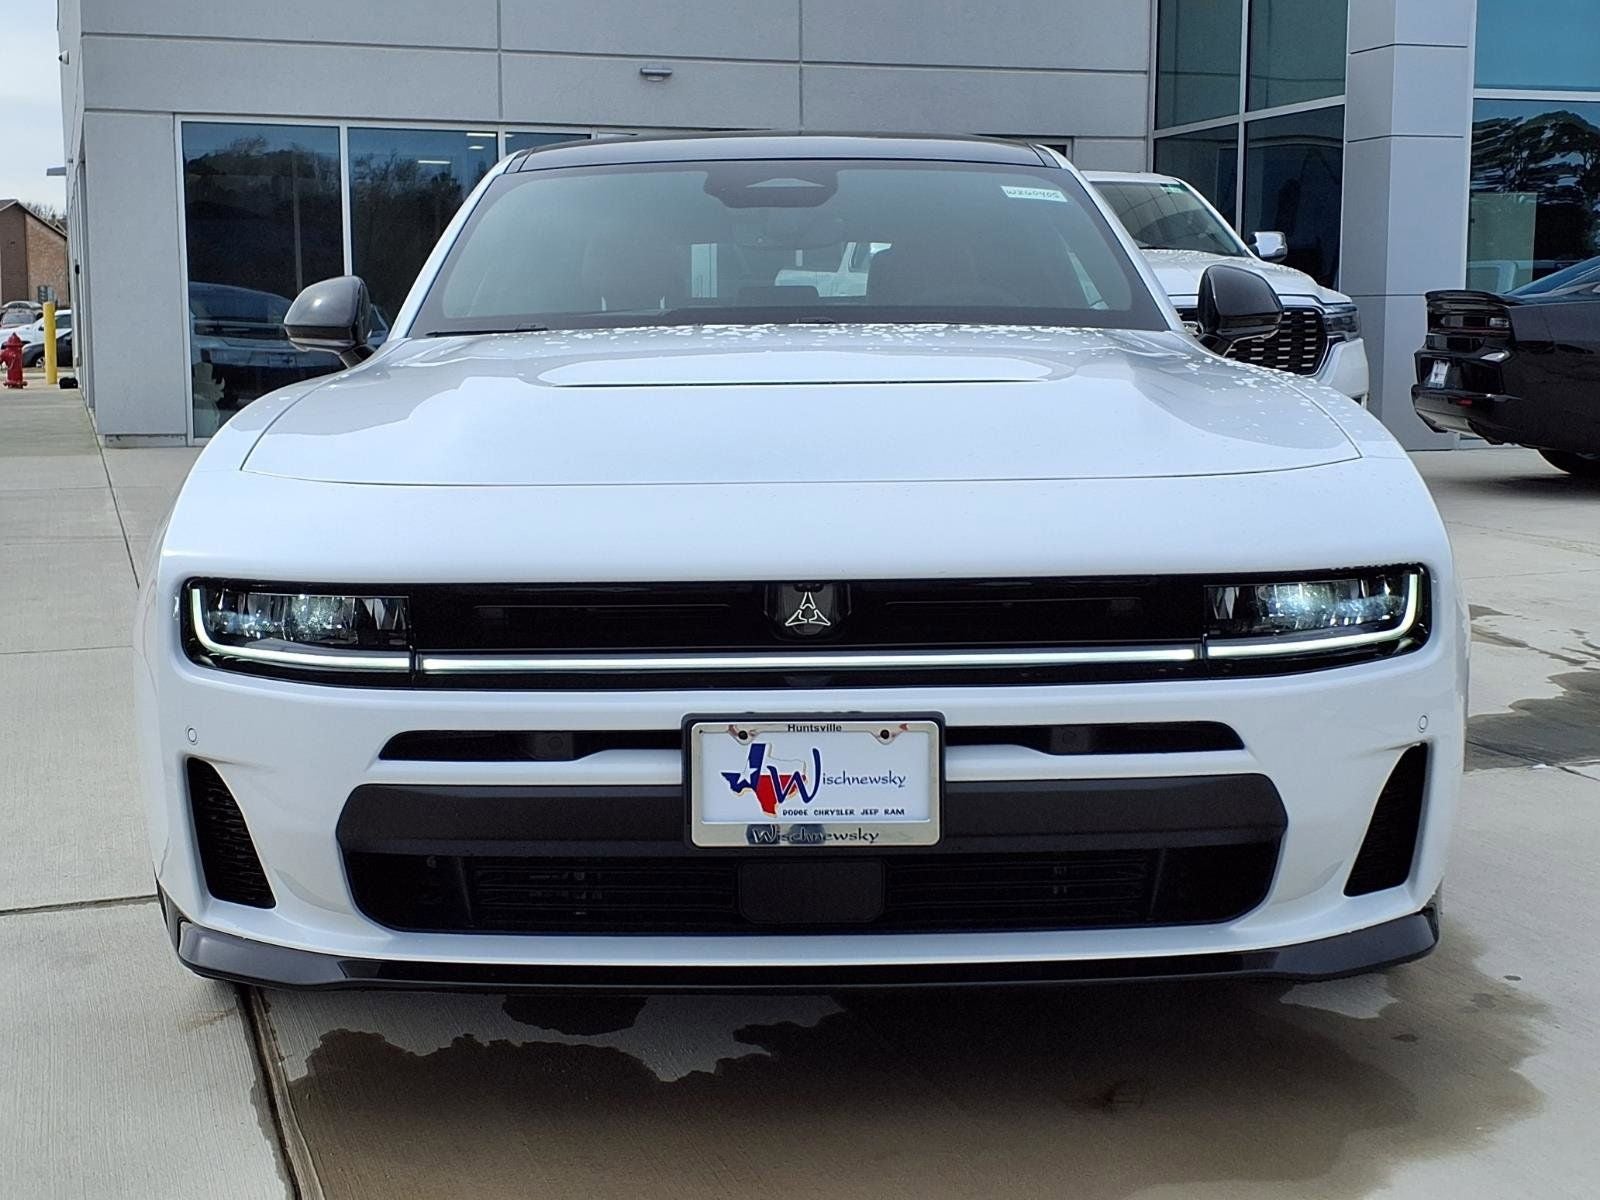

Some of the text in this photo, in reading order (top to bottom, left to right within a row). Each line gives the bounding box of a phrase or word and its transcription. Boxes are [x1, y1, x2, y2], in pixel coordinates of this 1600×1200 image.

[787, 723, 842, 733] Huntsville
[767, 747, 907, 804] Wischnewsky
[782, 808, 905, 816] DODGE CHRYSLER JEEP RAM
[752, 826, 880, 844] Wischnewsky
